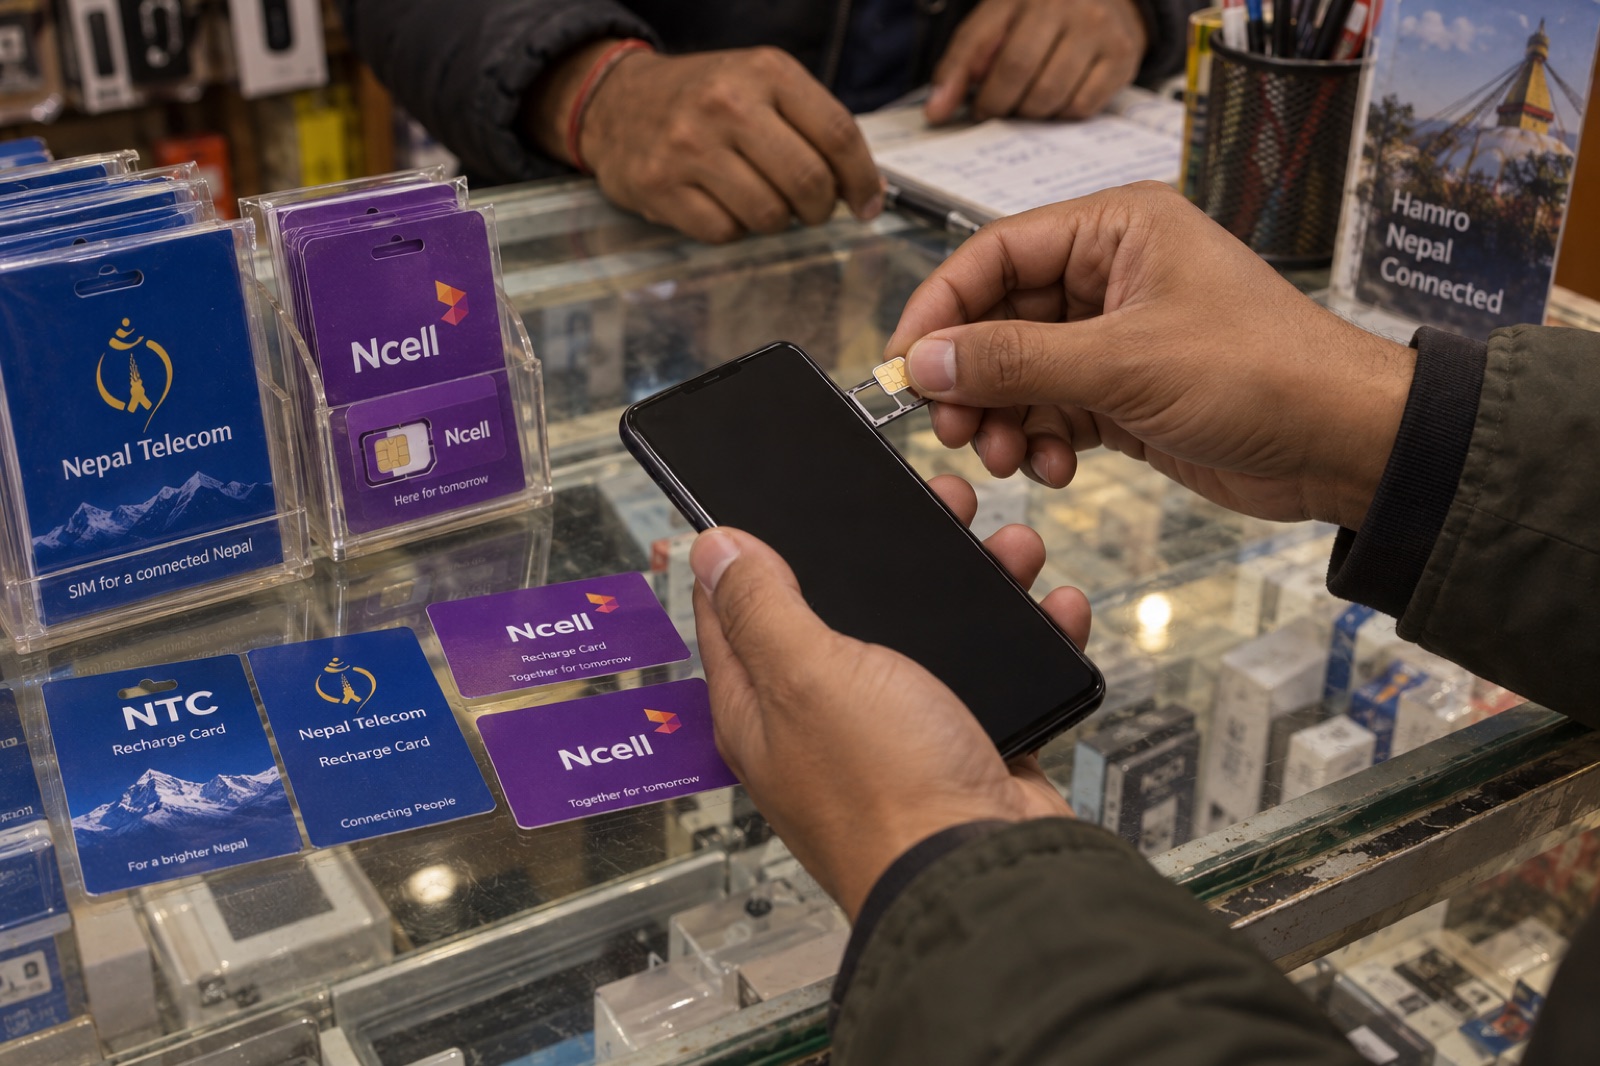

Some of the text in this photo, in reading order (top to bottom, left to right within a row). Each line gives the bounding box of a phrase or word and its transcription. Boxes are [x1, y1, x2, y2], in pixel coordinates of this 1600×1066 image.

[1392, 189, 1469, 232] Hamro
[1385, 223, 1453, 264] Nepal
[1380, 256, 1504, 315] Connected
[351, 325, 440, 373] Ncell
[445, 420, 491, 446] Ncell
[62, 425, 232, 481] Nepal Telecom
[394, 475, 489, 507] Here for tomorrow
[68, 538, 253, 599] SIM for a connected Nepal
[506, 613, 594, 642] Ncell
[509, 656, 632, 683] Together for tomorrow
[521, 642, 607, 663] Recharge Card
[122, 690, 219, 731] NTC
[298, 707, 427, 741] Nepal Telecom
[113, 723, 226, 756] Recharge Card
[319, 736, 431, 768] Recharge Card
[558, 734, 654, 770] Ncell
[568, 775, 700, 809] Together for tomorrow
[341, 798, 456, 829] Connecting People
[128, 838, 249, 872] For a brighter Nepal
